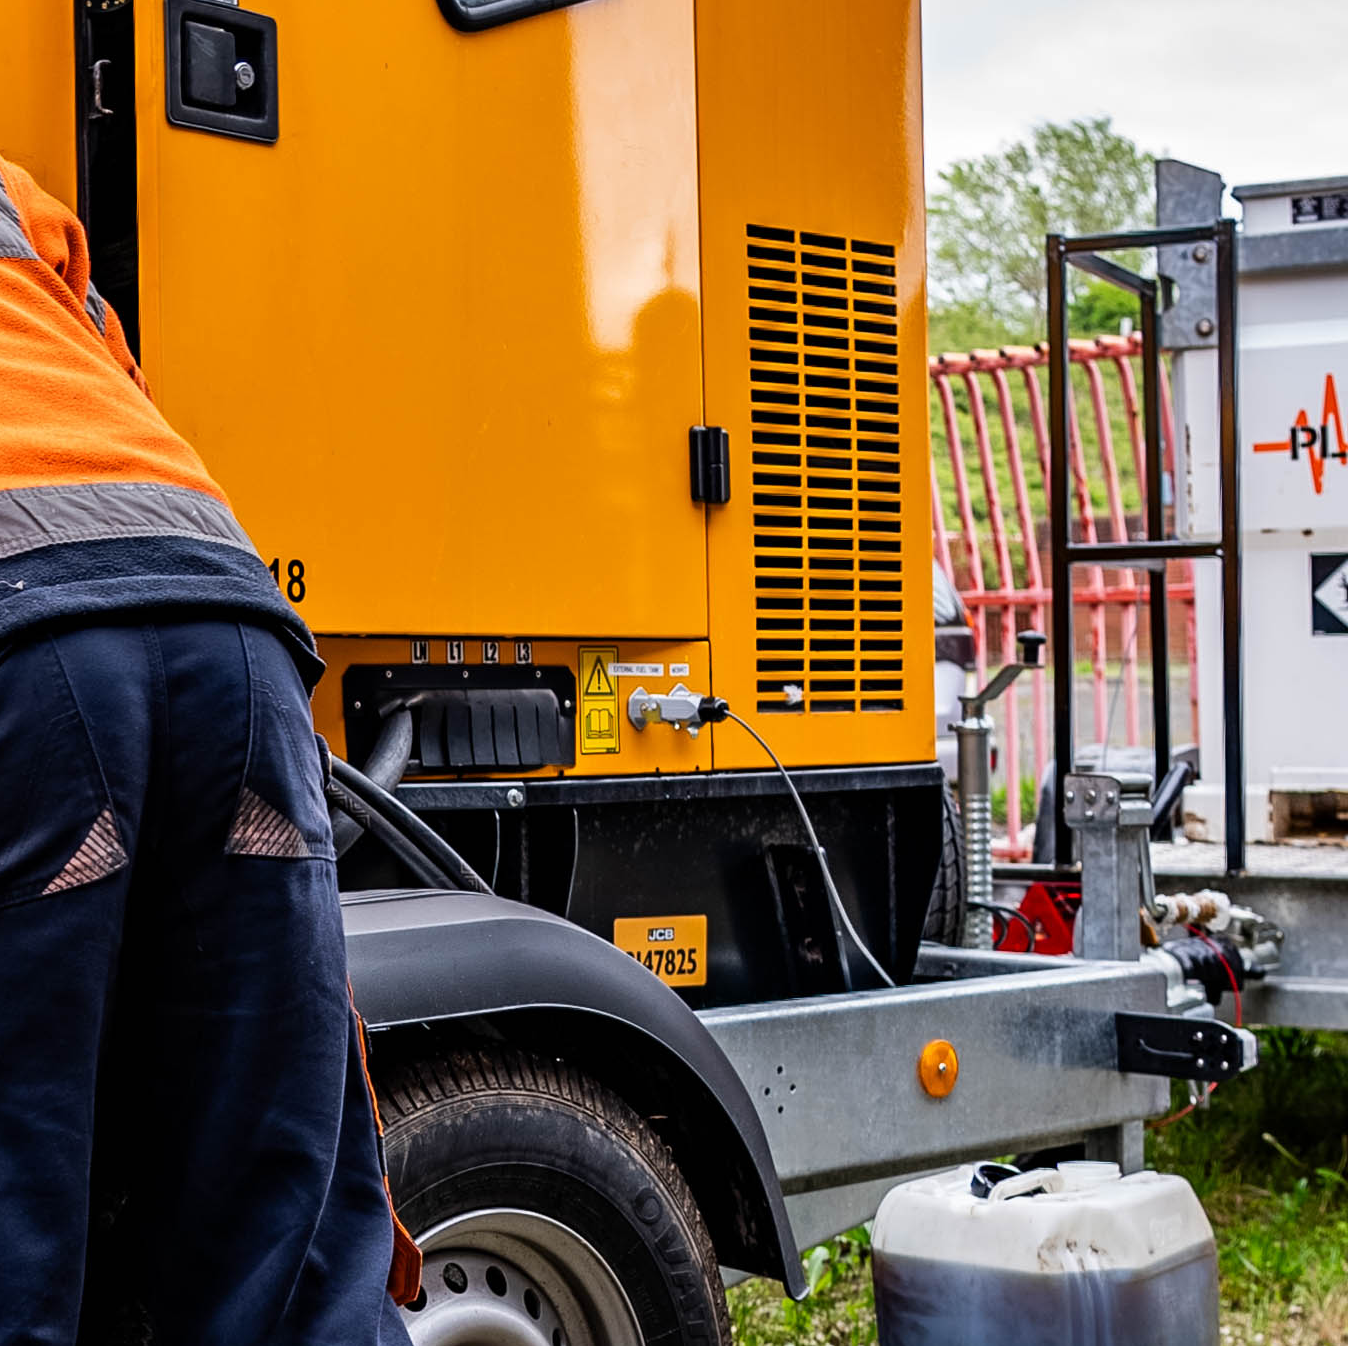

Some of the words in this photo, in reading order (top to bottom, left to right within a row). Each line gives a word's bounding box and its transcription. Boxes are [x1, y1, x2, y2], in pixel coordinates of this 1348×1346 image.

[449, 641, 462, 663] L1
[484, 641, 497, 663] L2
[517, 642, 531, 663] L3
[649, 928, 674, 941] JCB
